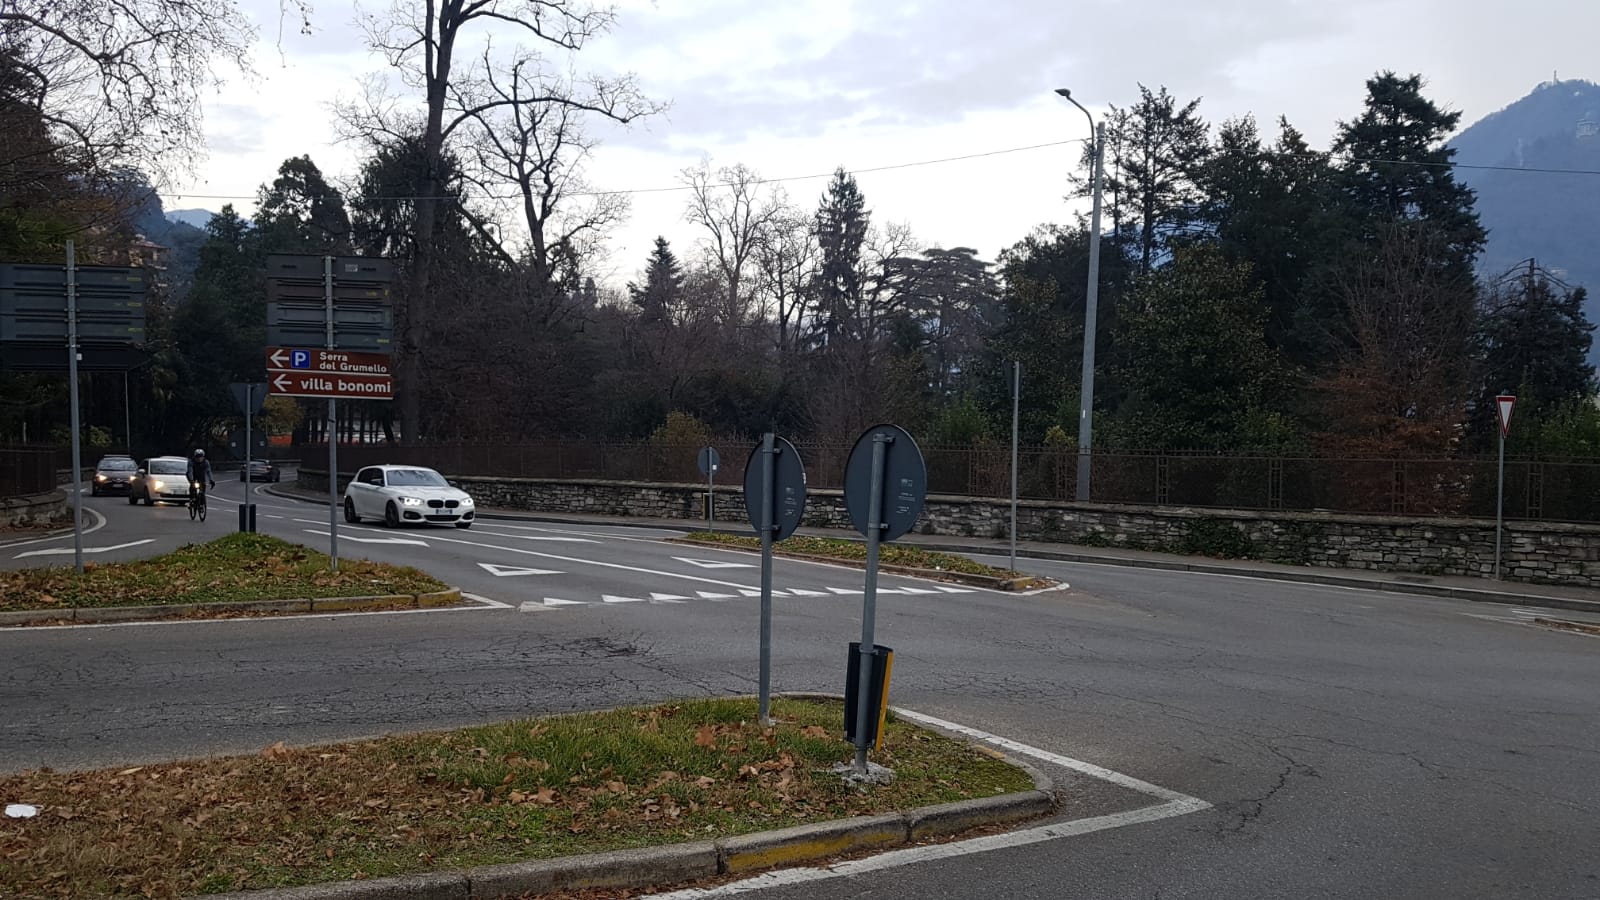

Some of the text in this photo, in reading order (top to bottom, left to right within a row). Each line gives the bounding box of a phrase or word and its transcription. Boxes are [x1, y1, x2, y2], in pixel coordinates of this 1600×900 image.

[294, 352, 306, 366] P
[320, 352, 348, 361] Serra
[320, 362, 387, 373] del Grumello
[301, 378, 391, 392] villa bonomi
